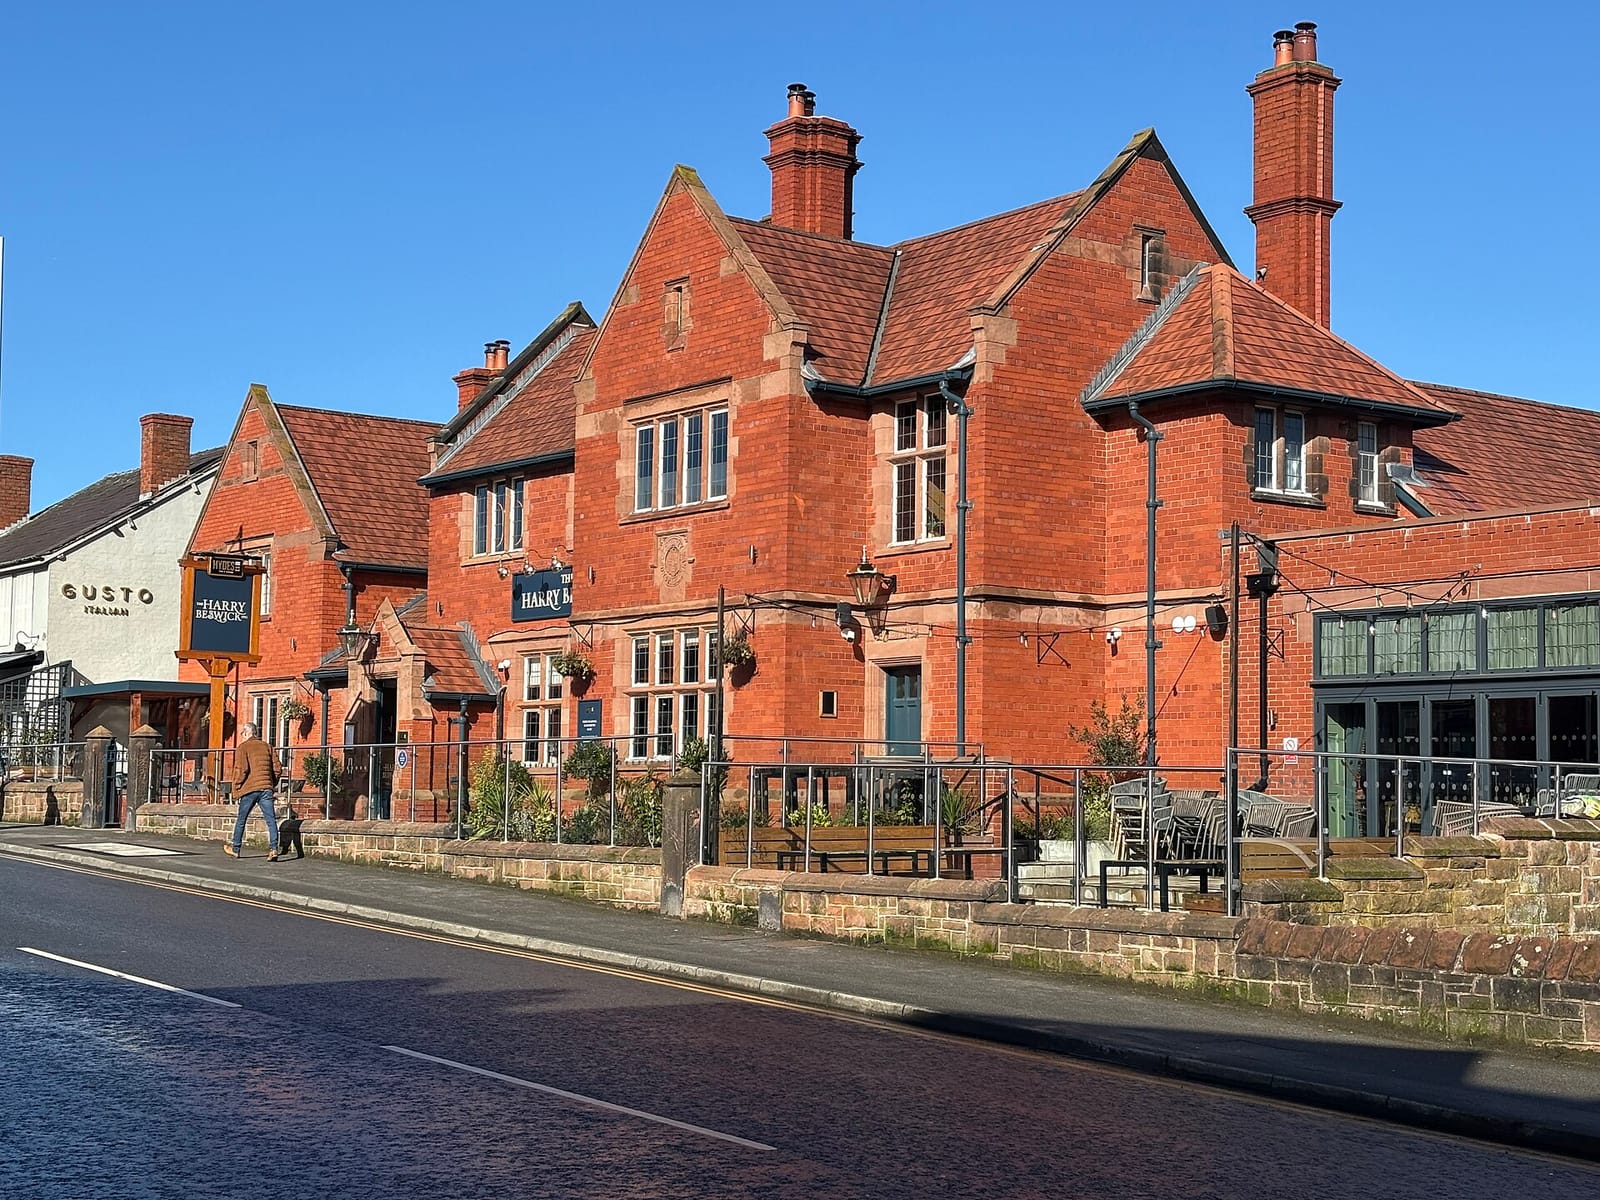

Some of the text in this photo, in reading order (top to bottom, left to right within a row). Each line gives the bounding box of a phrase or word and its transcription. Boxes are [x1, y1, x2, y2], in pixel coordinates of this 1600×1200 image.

[212, 559, 235, 571] HYDES
[61, 583, 154, 605] GUSTO
[521, 588, 562, 611] HARRY
[84, 605, 129, 617] ITALIAN
[203, 599, 247, 615] HARRY
[195, 609, 242, 623] BESWICK
